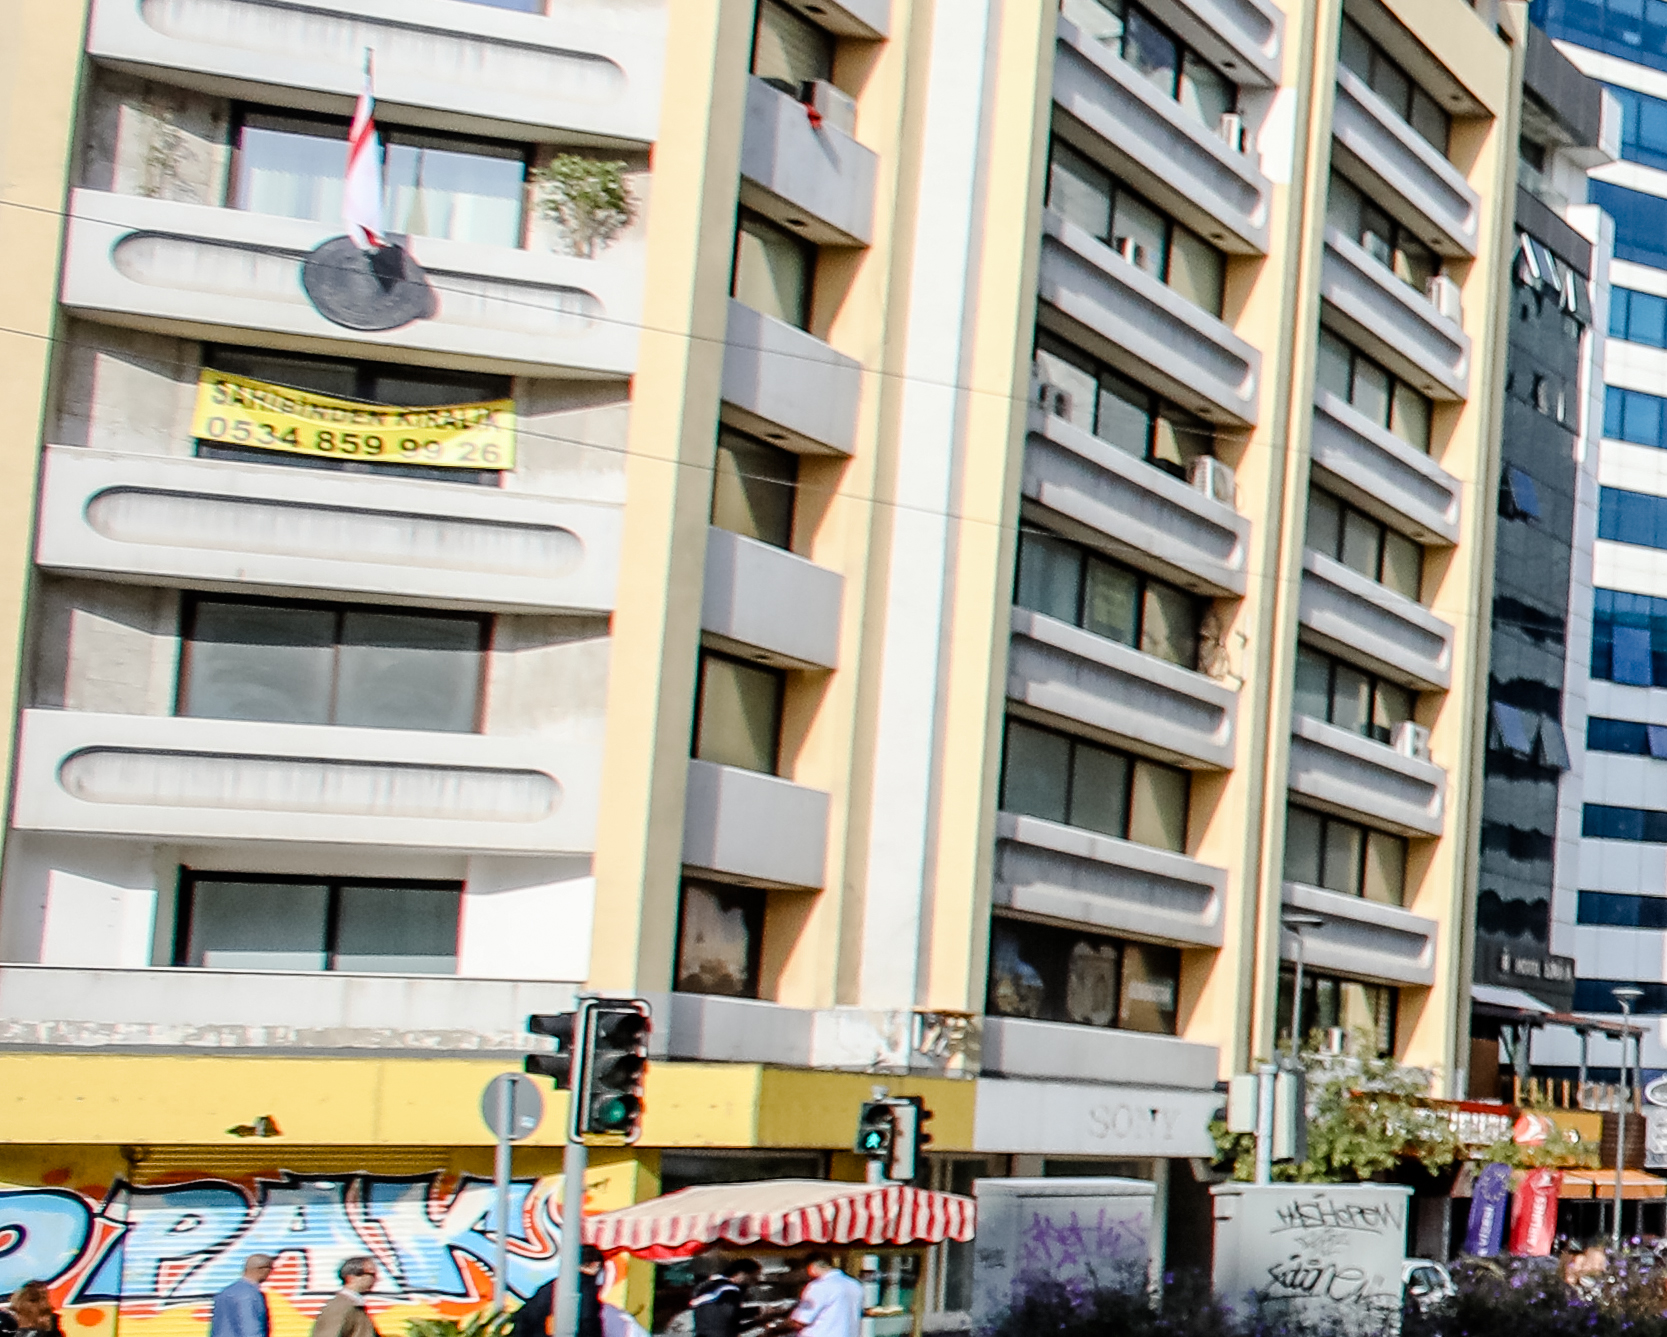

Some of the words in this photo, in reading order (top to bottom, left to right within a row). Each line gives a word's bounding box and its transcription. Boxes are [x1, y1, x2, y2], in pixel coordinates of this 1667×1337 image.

[206, 415, 300, 448] 0534
[315, 429, 384, 456] 859
[399, 437, 444, 460] 99
[458, 440, 502, 464] 26
[1089, 1103, 1182, 1139] SONY
